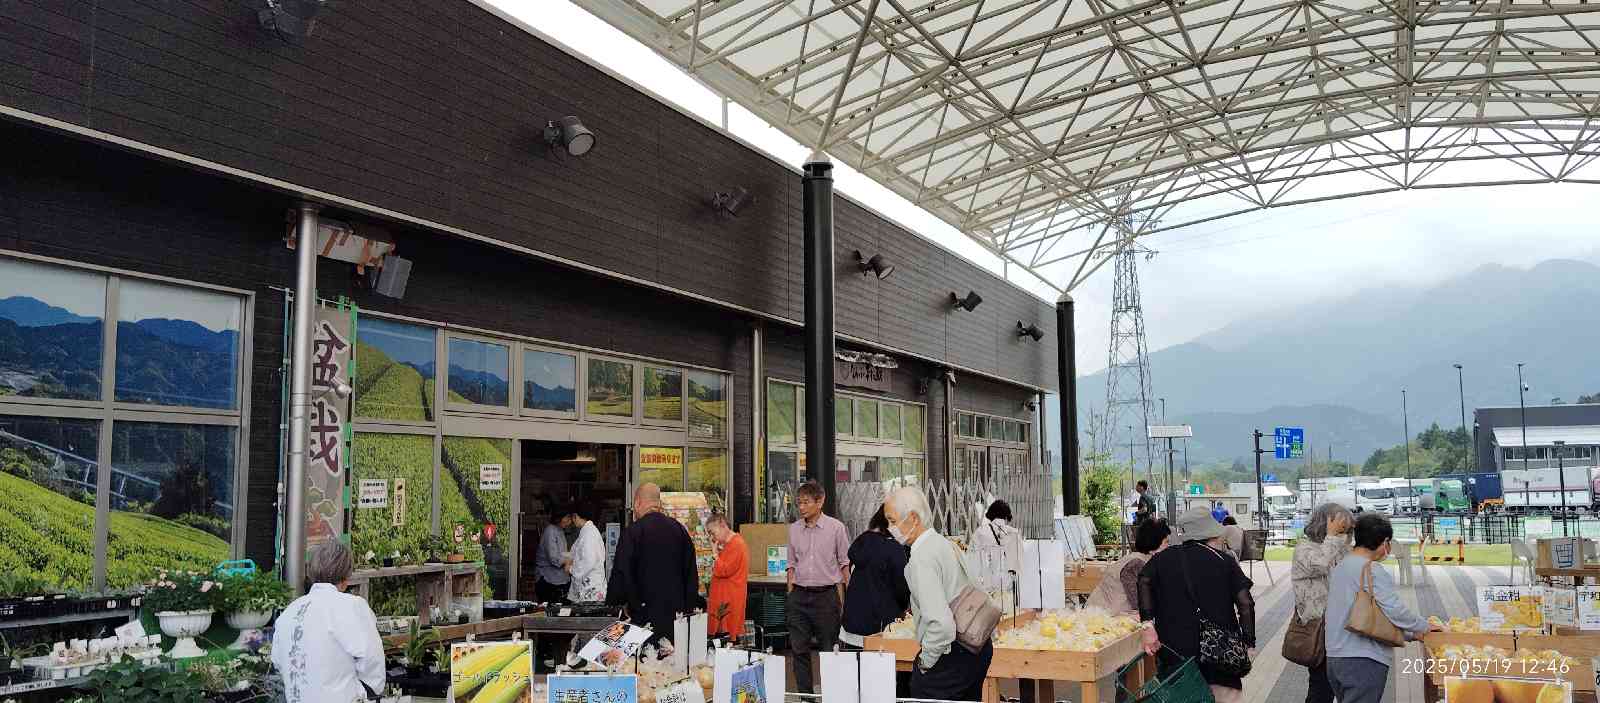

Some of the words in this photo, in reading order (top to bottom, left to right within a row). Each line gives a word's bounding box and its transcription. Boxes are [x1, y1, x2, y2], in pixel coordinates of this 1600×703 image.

[453, 671, 530, 684] ゴールドラッシュ
